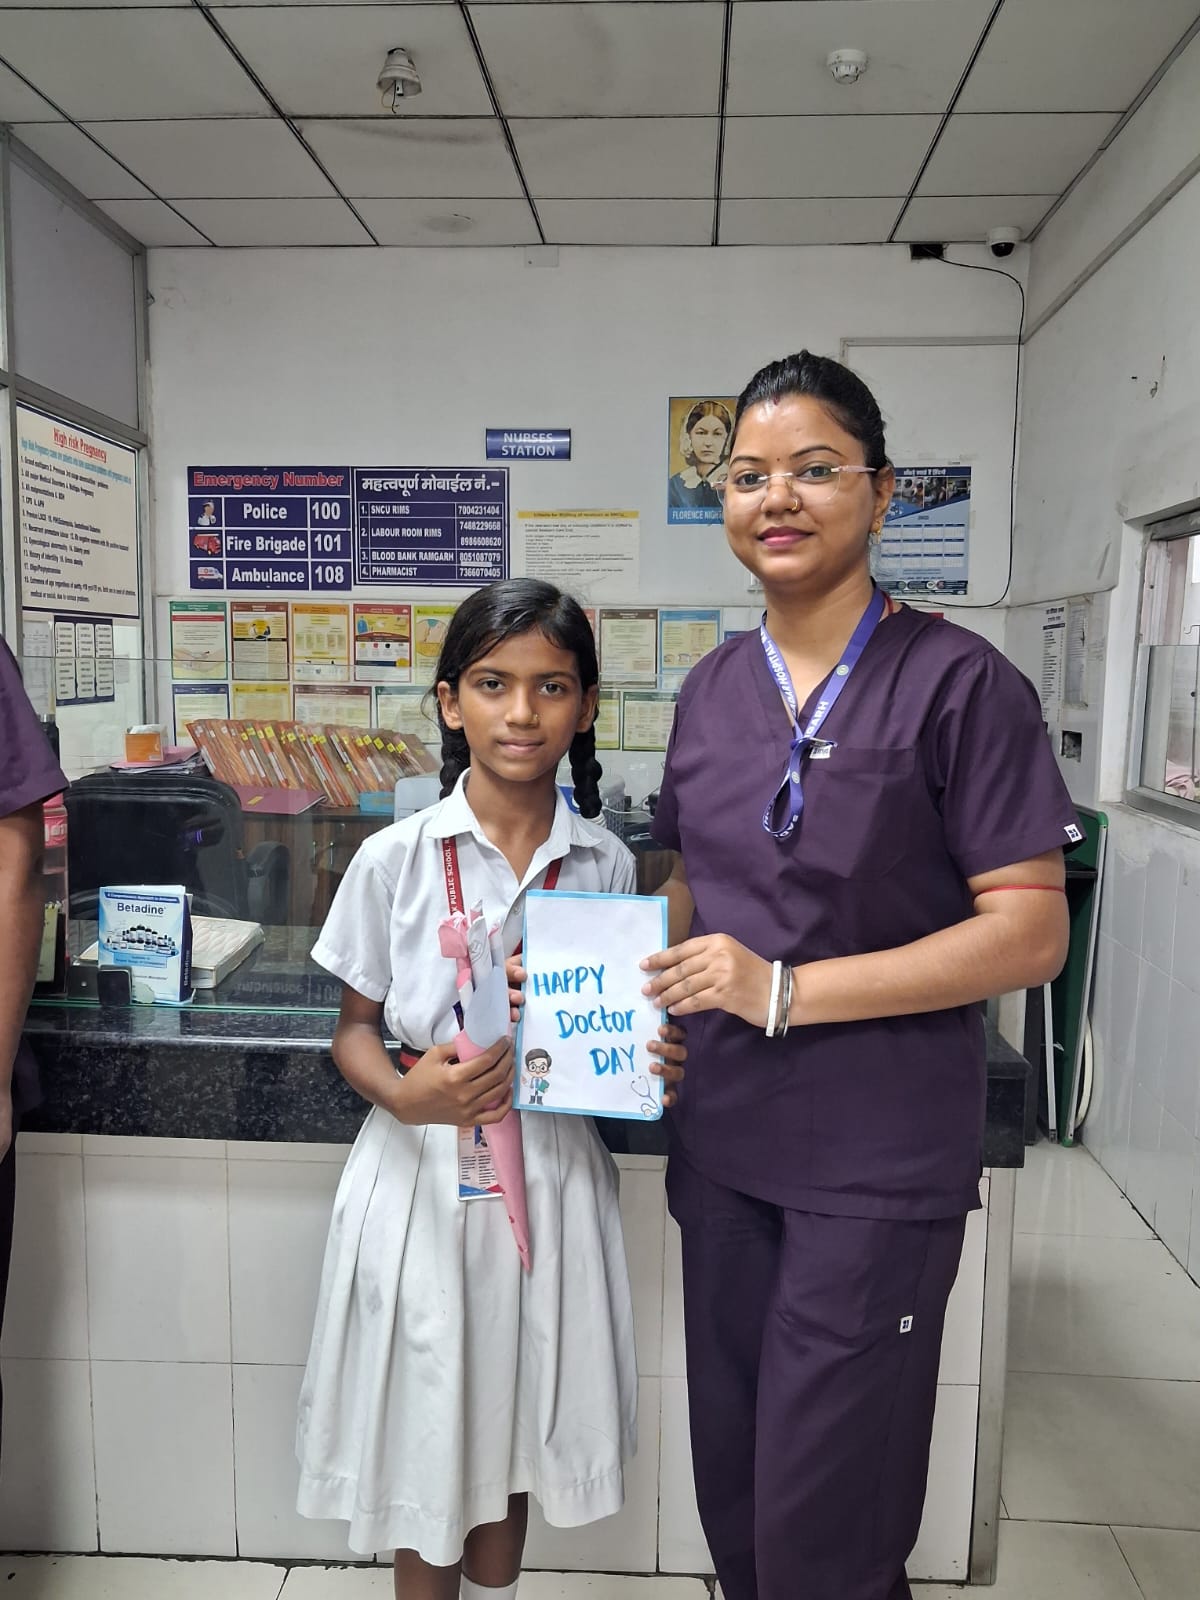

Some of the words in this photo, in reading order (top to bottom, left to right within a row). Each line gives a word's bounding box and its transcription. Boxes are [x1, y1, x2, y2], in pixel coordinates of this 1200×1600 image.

[54, 428, 67, 447] High
[68, 435, 79, 448] risk
[80, 438, 107, 462] Pregnancy
[504, 433, 553, 443] NURSES
[501, 445, 556, 456] STATION
[193, 472, 279, 490] Emergency
[283, 472, 344, 487] Number
[362, 473, 419, 497] महत्वपूर्ण
[243, 503, 288, 519] Police
[312, 502, 341, 520] 100
[361, 505, 367, 514] 1.
[371, 505, 391, 514] SNCU
[392, 505, 410, 514] RIMS
[672, 510, 704, 520] FLORENCE
[361, 528, 368, 537] 2.
[371, 528, 400, 537] LABOUR
[401, 528, 423, 537] ROOM
[424, 528, 442, 537] RIMS
[226, 536, 252, 551] Fire
[255, 536, 306, 555] Brigade
[314, 534, 342, 552] 101
[361, 552, 368, 561] 3.
[372, 551, 396, 561] BLOOD
[397, 551, 417, 561] BANK
[418, 551, 454, 561] RAMGARH
[231, 568, 305, 582] Ambulance
[315, 565, 344, 583] 108
[361, 567, 369, 576] 4.
[372, 567, 418, 576] PHARMACIST
[448, 876, 457, 905] PUBLIC
[117, 902, 164, 915] Betadine
[533, 964, 605, 996] HAPPY
[555, 1004, 636, 1039] Doctor
[589, 1044, 636, 1076] DAY
